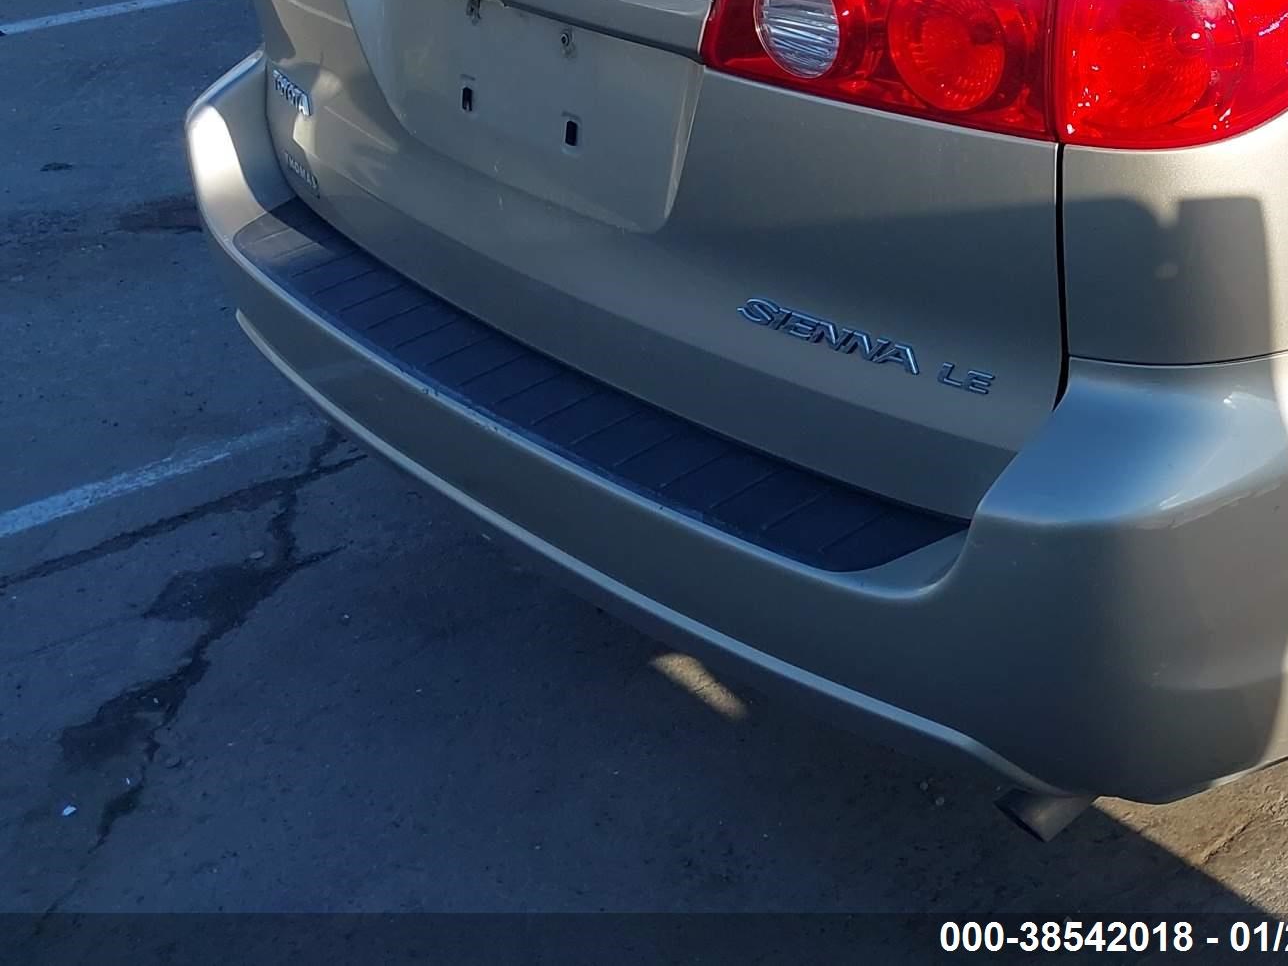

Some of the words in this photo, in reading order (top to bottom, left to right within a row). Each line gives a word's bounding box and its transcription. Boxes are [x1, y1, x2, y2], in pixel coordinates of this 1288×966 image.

[272, 69, 313, 117] TOYOTA
[736, 297, 921, 376] SIENNA
[937, 362, 996, 395] LE
